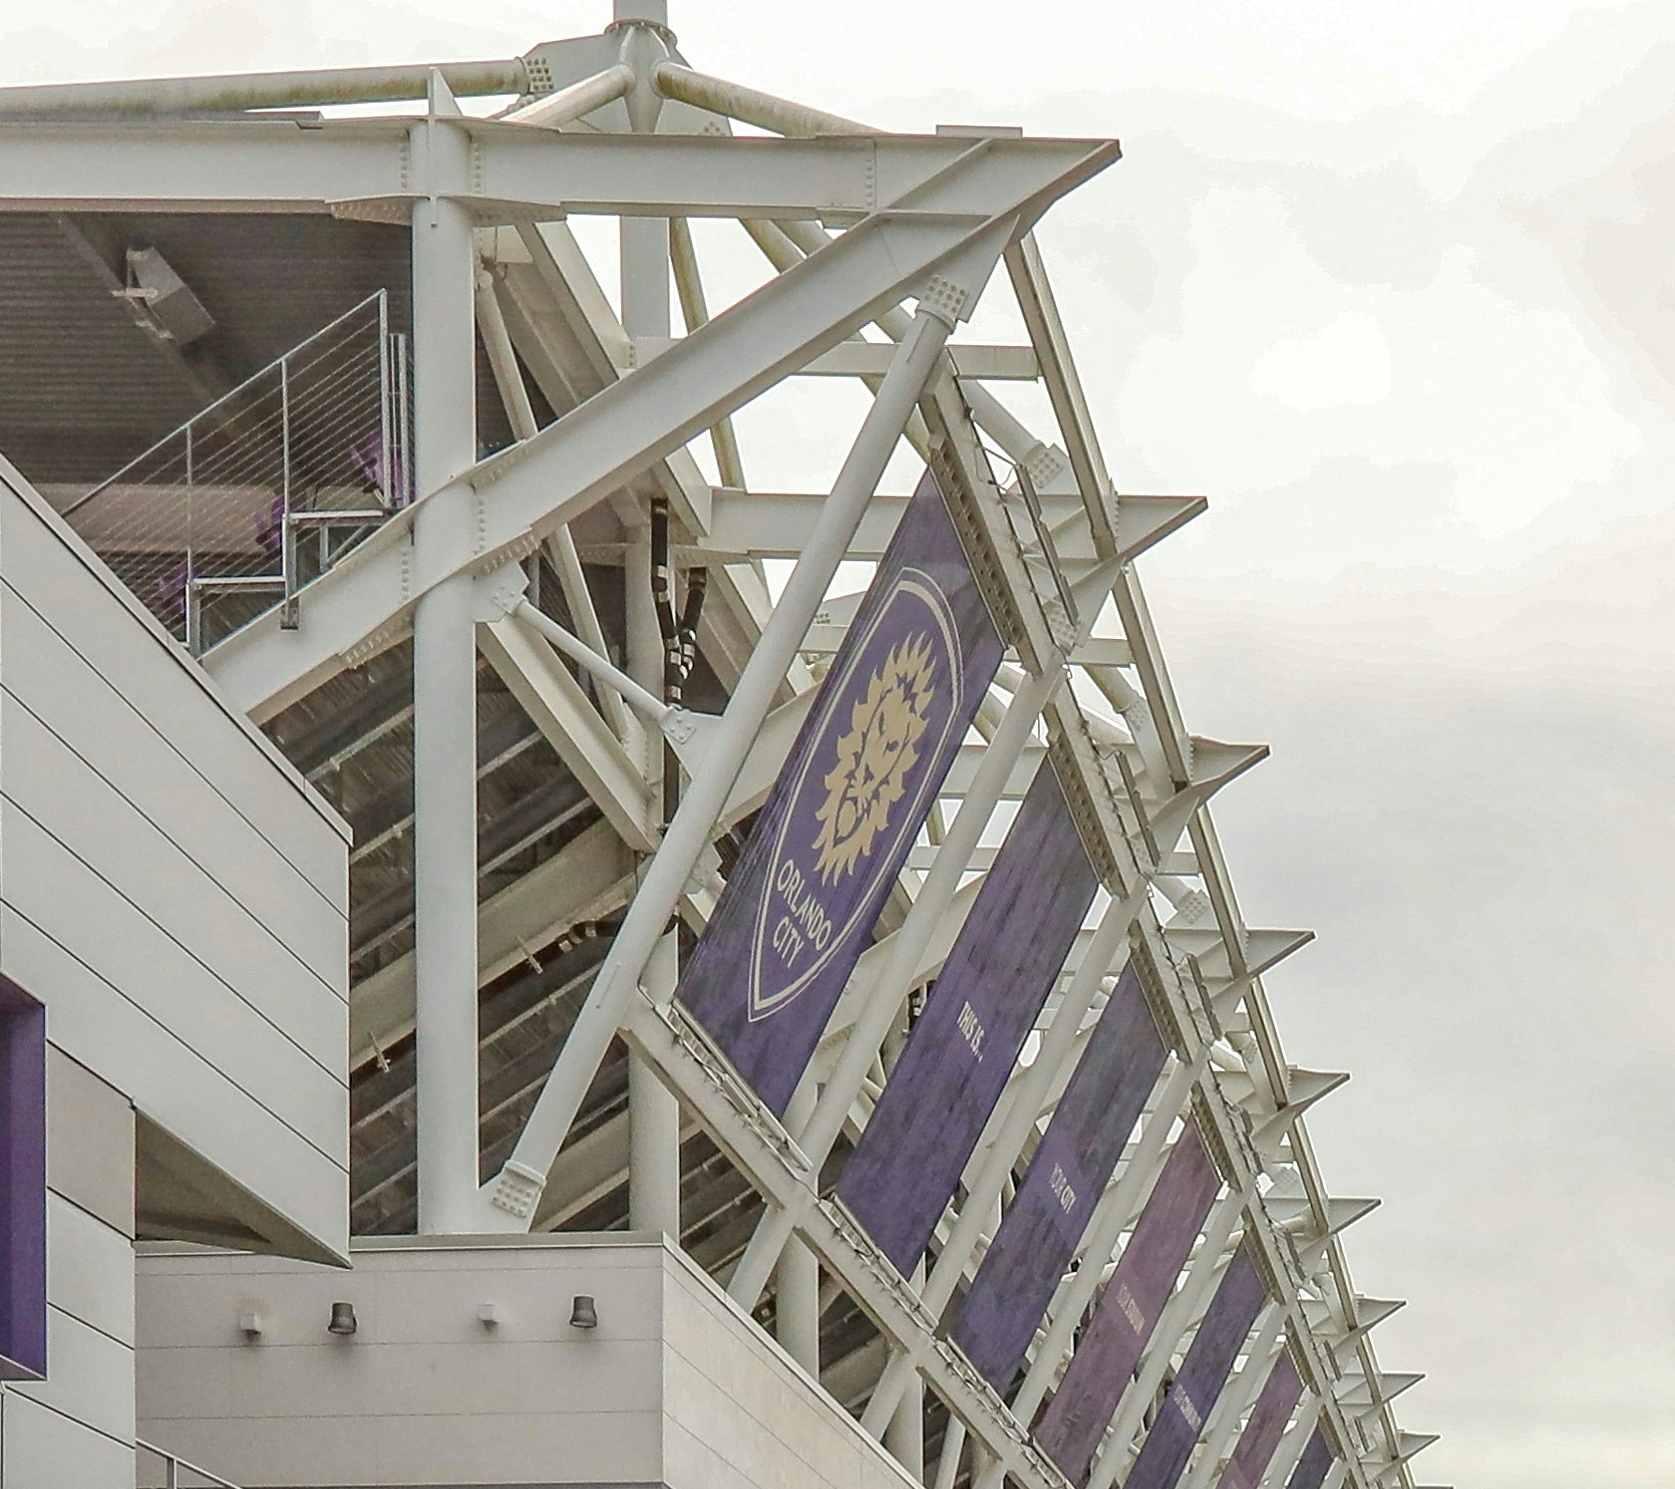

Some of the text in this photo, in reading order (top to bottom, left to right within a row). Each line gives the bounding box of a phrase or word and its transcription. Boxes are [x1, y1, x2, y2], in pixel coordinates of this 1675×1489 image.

[777, 859, 832, 950] ORLANDO
[773, 916, 805, 968] CITY
[957, 1001, 976, 1040] THIS
